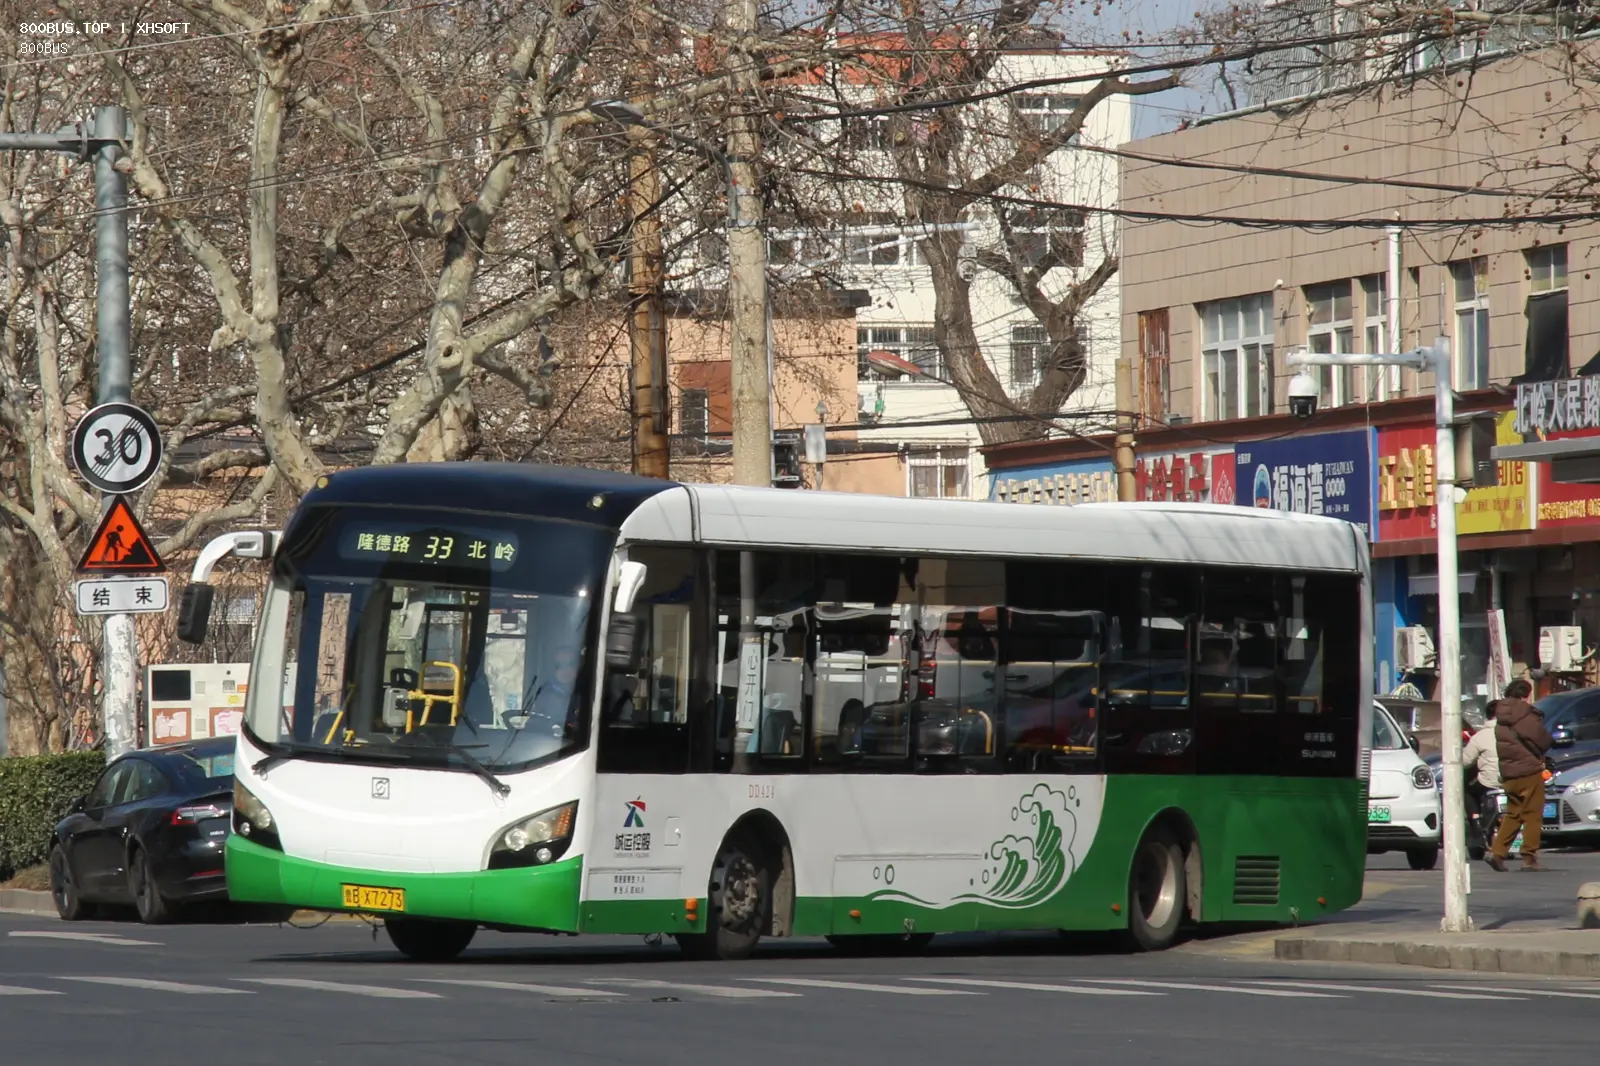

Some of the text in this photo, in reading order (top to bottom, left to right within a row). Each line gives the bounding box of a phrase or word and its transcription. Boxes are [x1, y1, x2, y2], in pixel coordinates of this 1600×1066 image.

[94, 428, 142, 466] 30
[1272, 463, 1324, 514] 福海湾
[357, 532, 411, 553] 隆德路
[424, 536, 454, 559] 33
[92, 585, 153, 606] 结束
[614, 833, 651, 851] 城运控股
